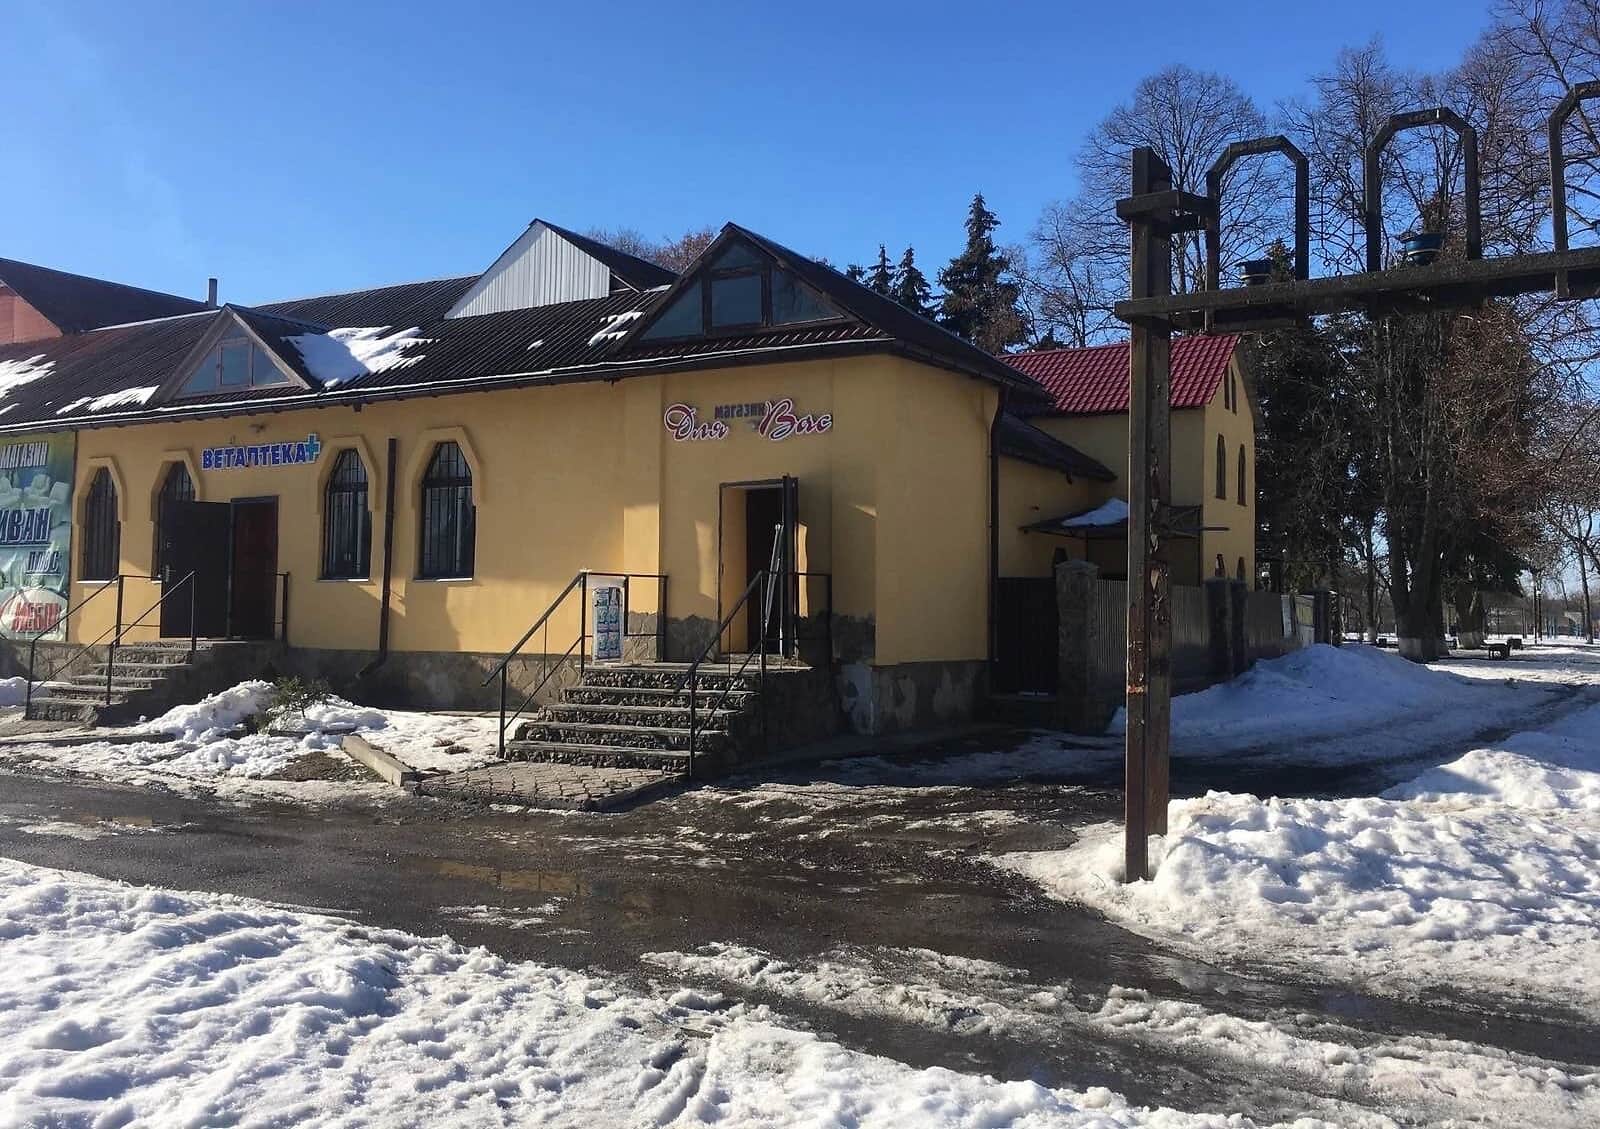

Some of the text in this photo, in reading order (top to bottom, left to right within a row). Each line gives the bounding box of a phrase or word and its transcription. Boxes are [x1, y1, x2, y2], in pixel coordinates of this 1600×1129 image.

[664, 399, 833, 441] Для Вас
[202, 443, 307, 470] ВЕТАПТЕКА
